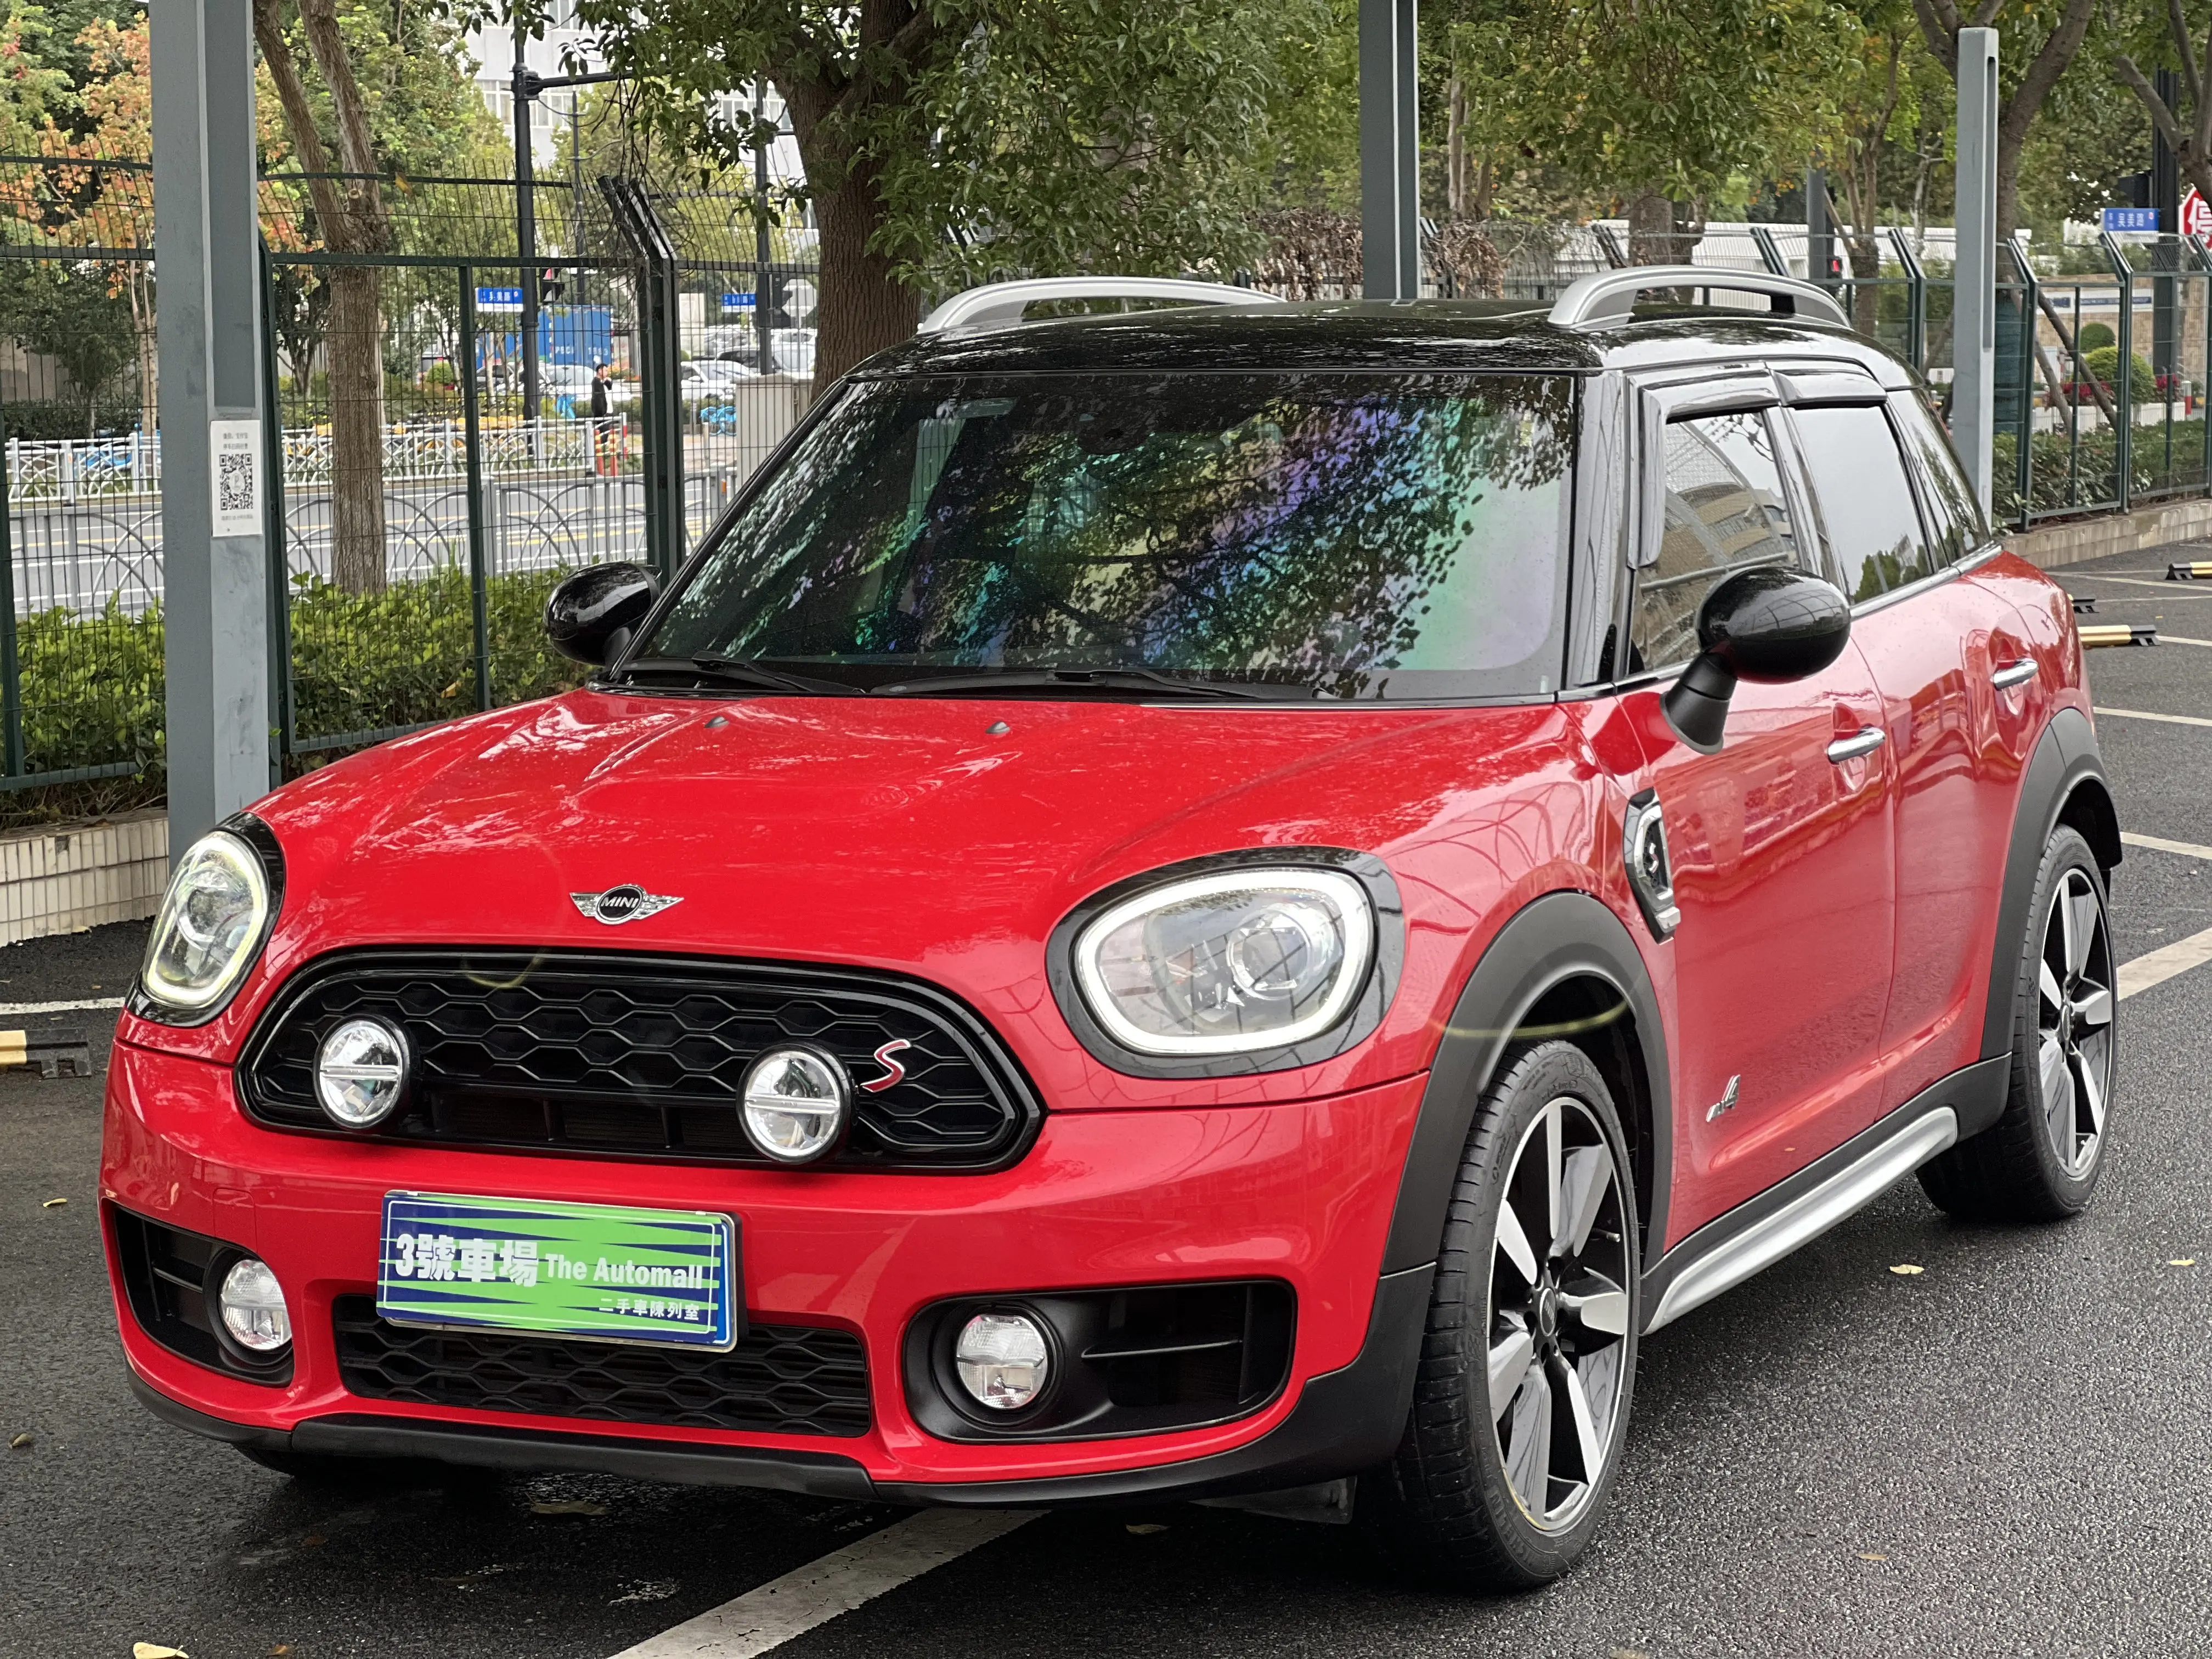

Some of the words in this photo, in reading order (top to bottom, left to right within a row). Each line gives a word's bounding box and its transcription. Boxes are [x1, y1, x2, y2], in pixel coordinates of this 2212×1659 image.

[601, 896, 639, 909] MINI
[860, 1039, 911, 1092] S
[396, 1233, 539, 1287] 3號車場
[545, 1253, 588, 1280] The
[594, 1257, 703, 1289] Automall
[598, 1298, 701, 1321] 二手車陳列室
